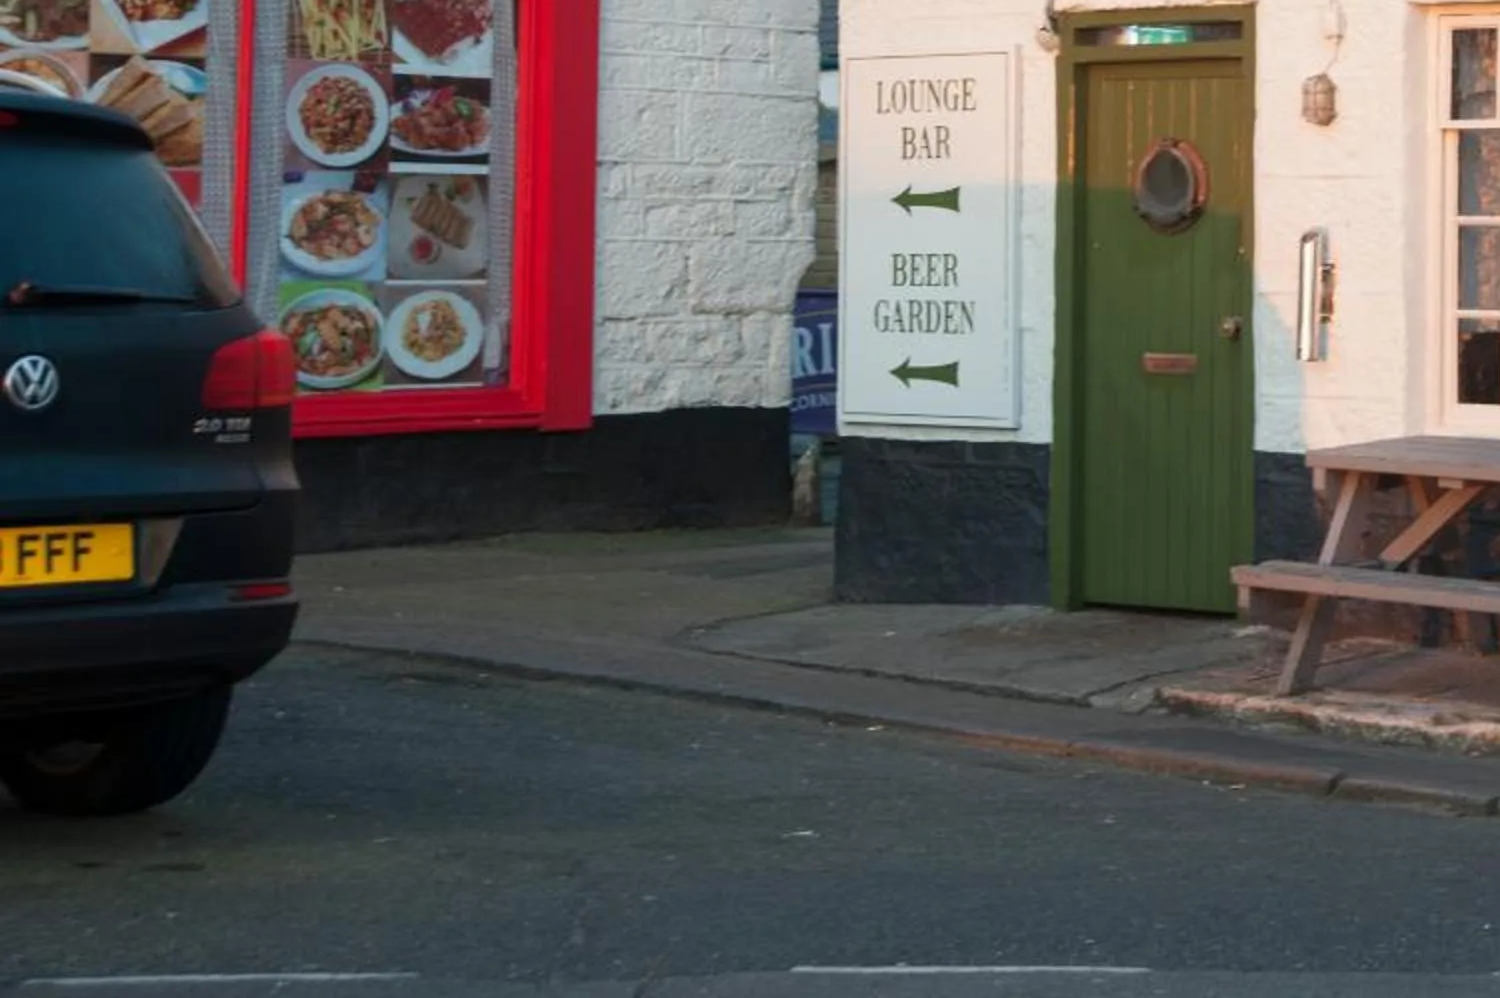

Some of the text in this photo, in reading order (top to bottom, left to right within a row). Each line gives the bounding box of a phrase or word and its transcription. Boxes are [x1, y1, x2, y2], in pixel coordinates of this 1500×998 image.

[876, 77, 978, 114] LOUNGE
[901, 124, 952, 160] BAR
[892, 252, 960, 288] BEER
[873, 299, 976, 335] GARDEN
